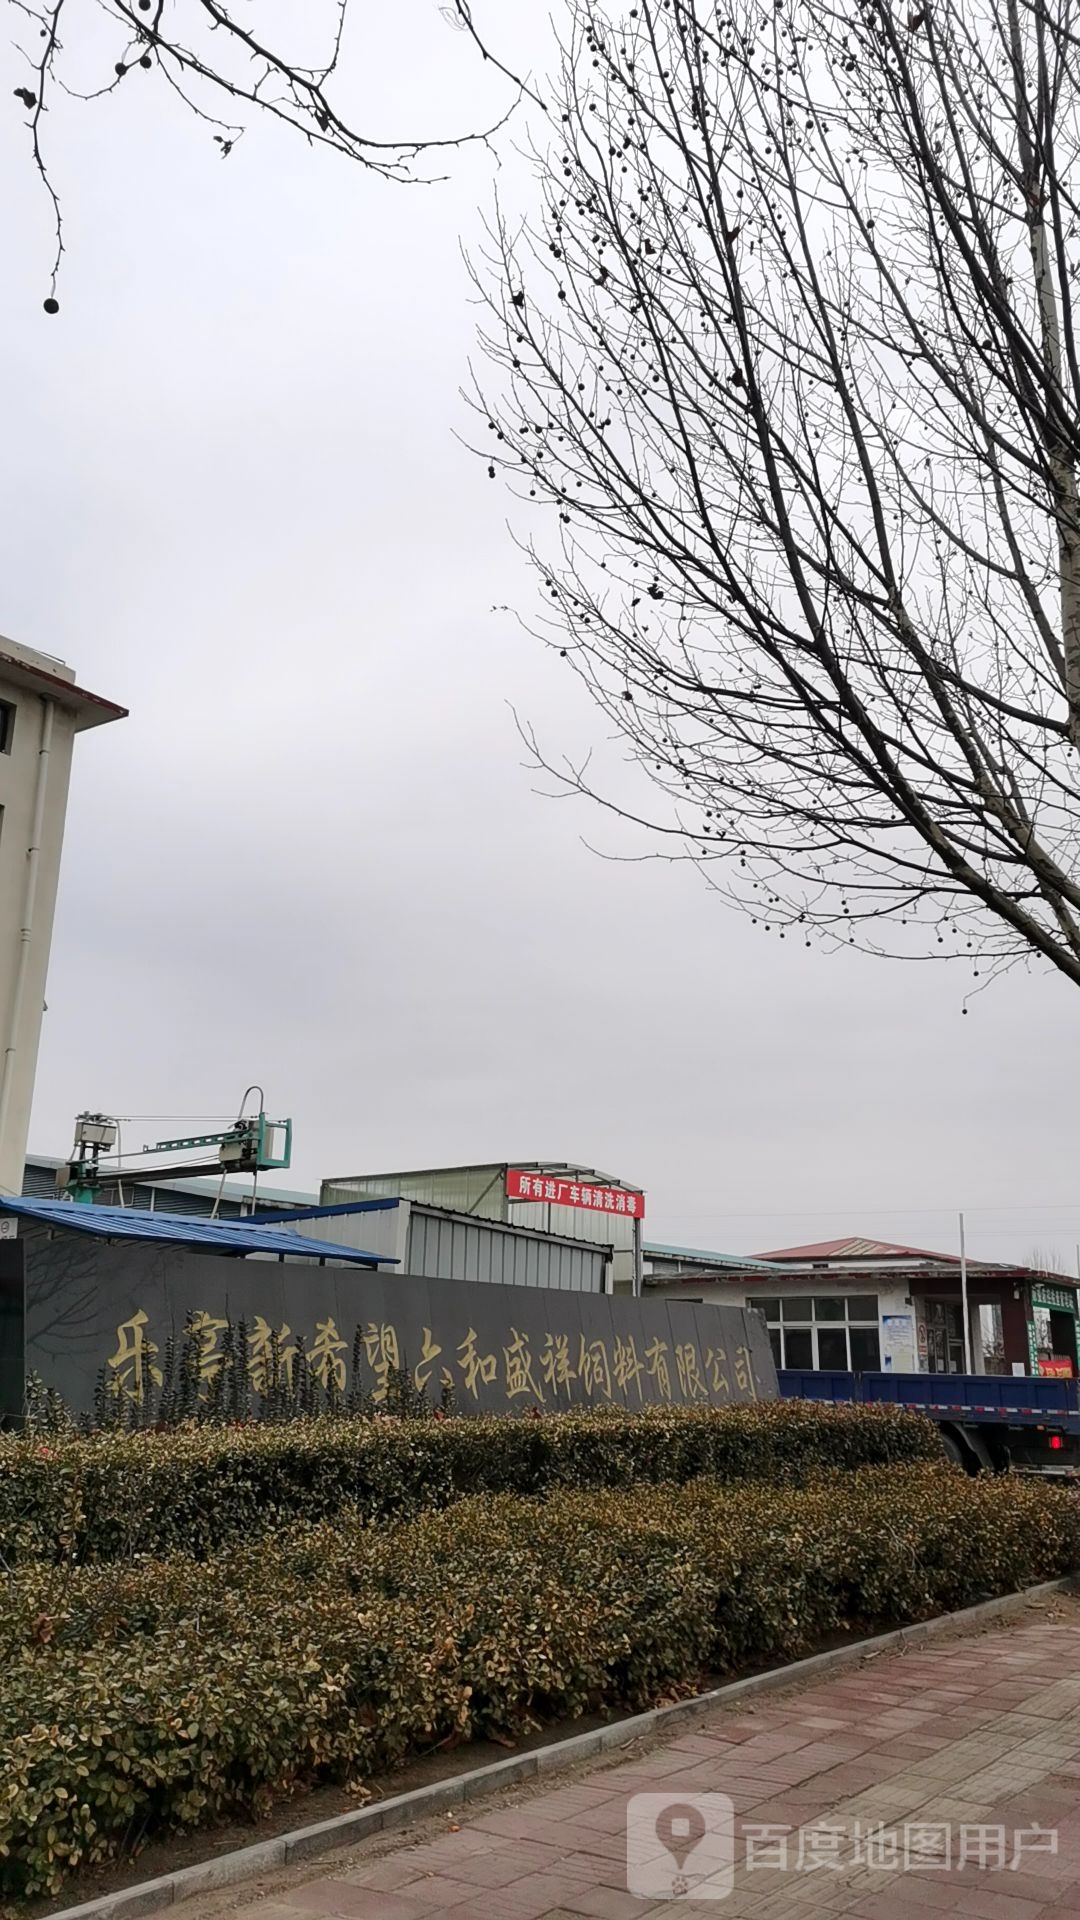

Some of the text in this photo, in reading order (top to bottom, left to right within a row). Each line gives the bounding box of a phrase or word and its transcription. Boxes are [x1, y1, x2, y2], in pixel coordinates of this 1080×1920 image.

[519, 1176, 637, 1214] 所有进厂车辆清洗消毒
